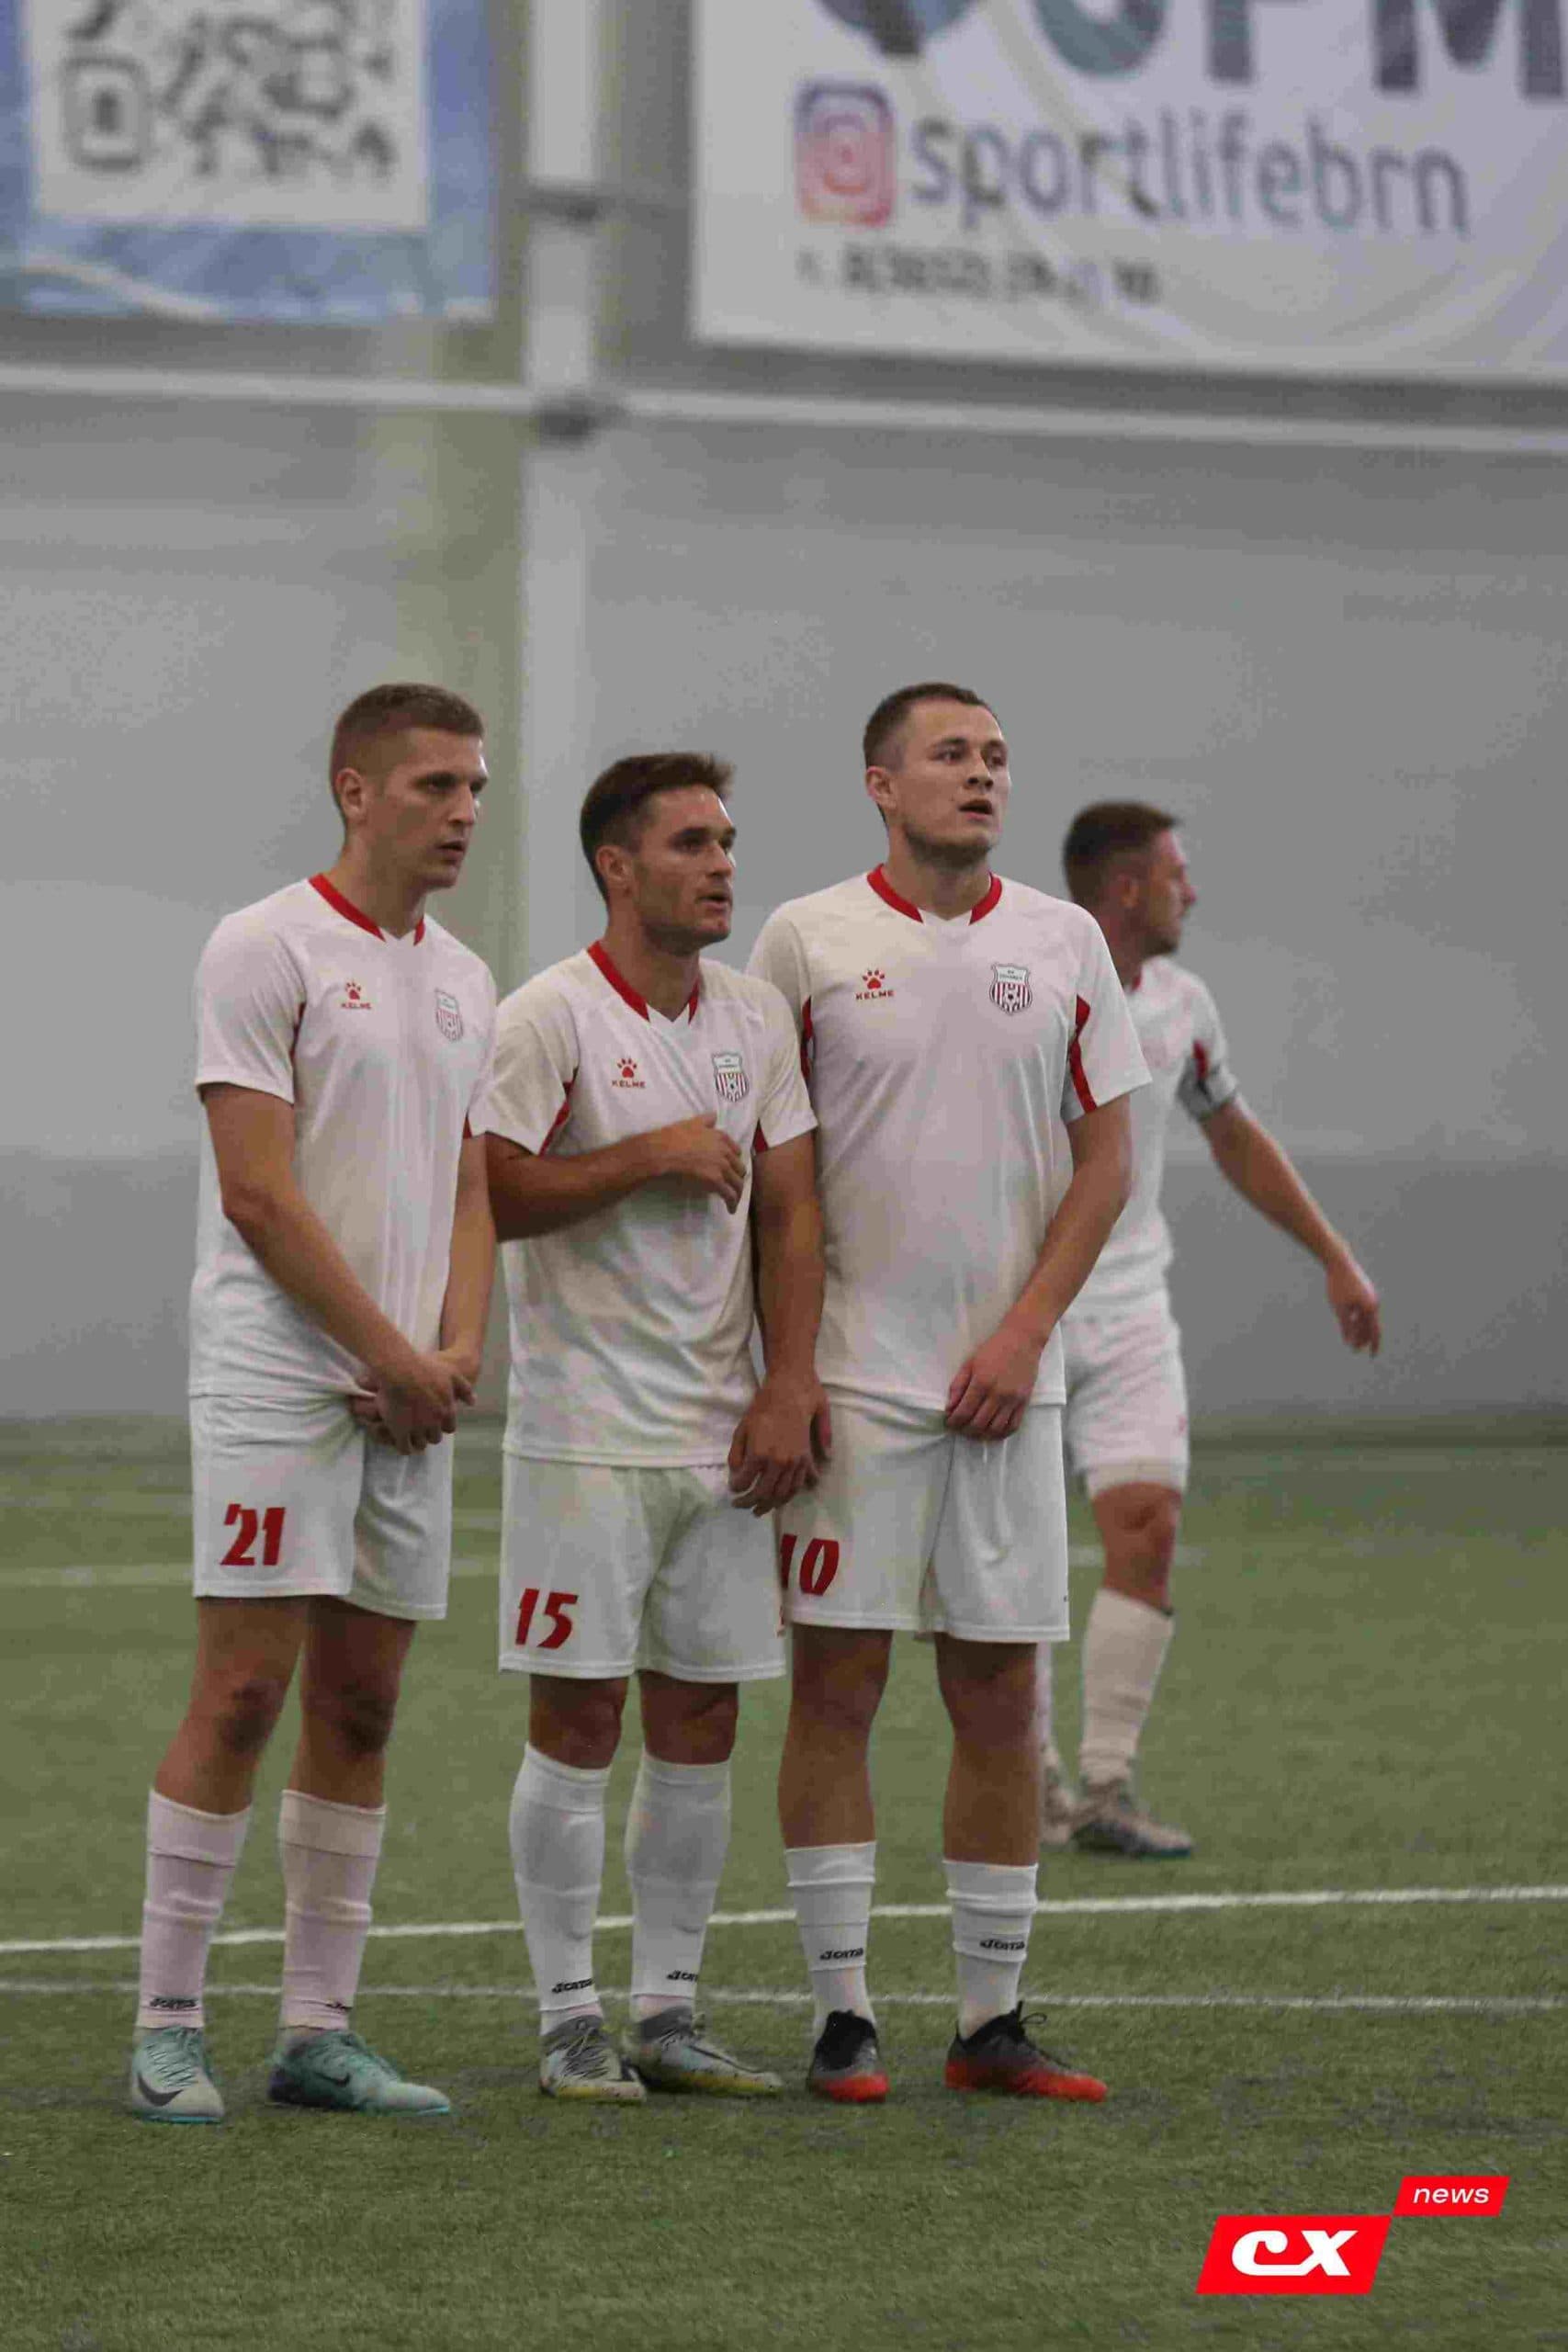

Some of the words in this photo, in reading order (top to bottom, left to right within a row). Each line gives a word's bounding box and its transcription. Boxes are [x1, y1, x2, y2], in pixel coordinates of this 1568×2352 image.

[911, 103, 1468, 238] sportlifebrn
[855, 989, 895, 1001] KELME
[611, 1080, 646, 1089] KELME
[220, 1503, 287, 1566] 21
[779, 1532, 840, 1597] 10
[514, 1587, 580, 1650] 15
